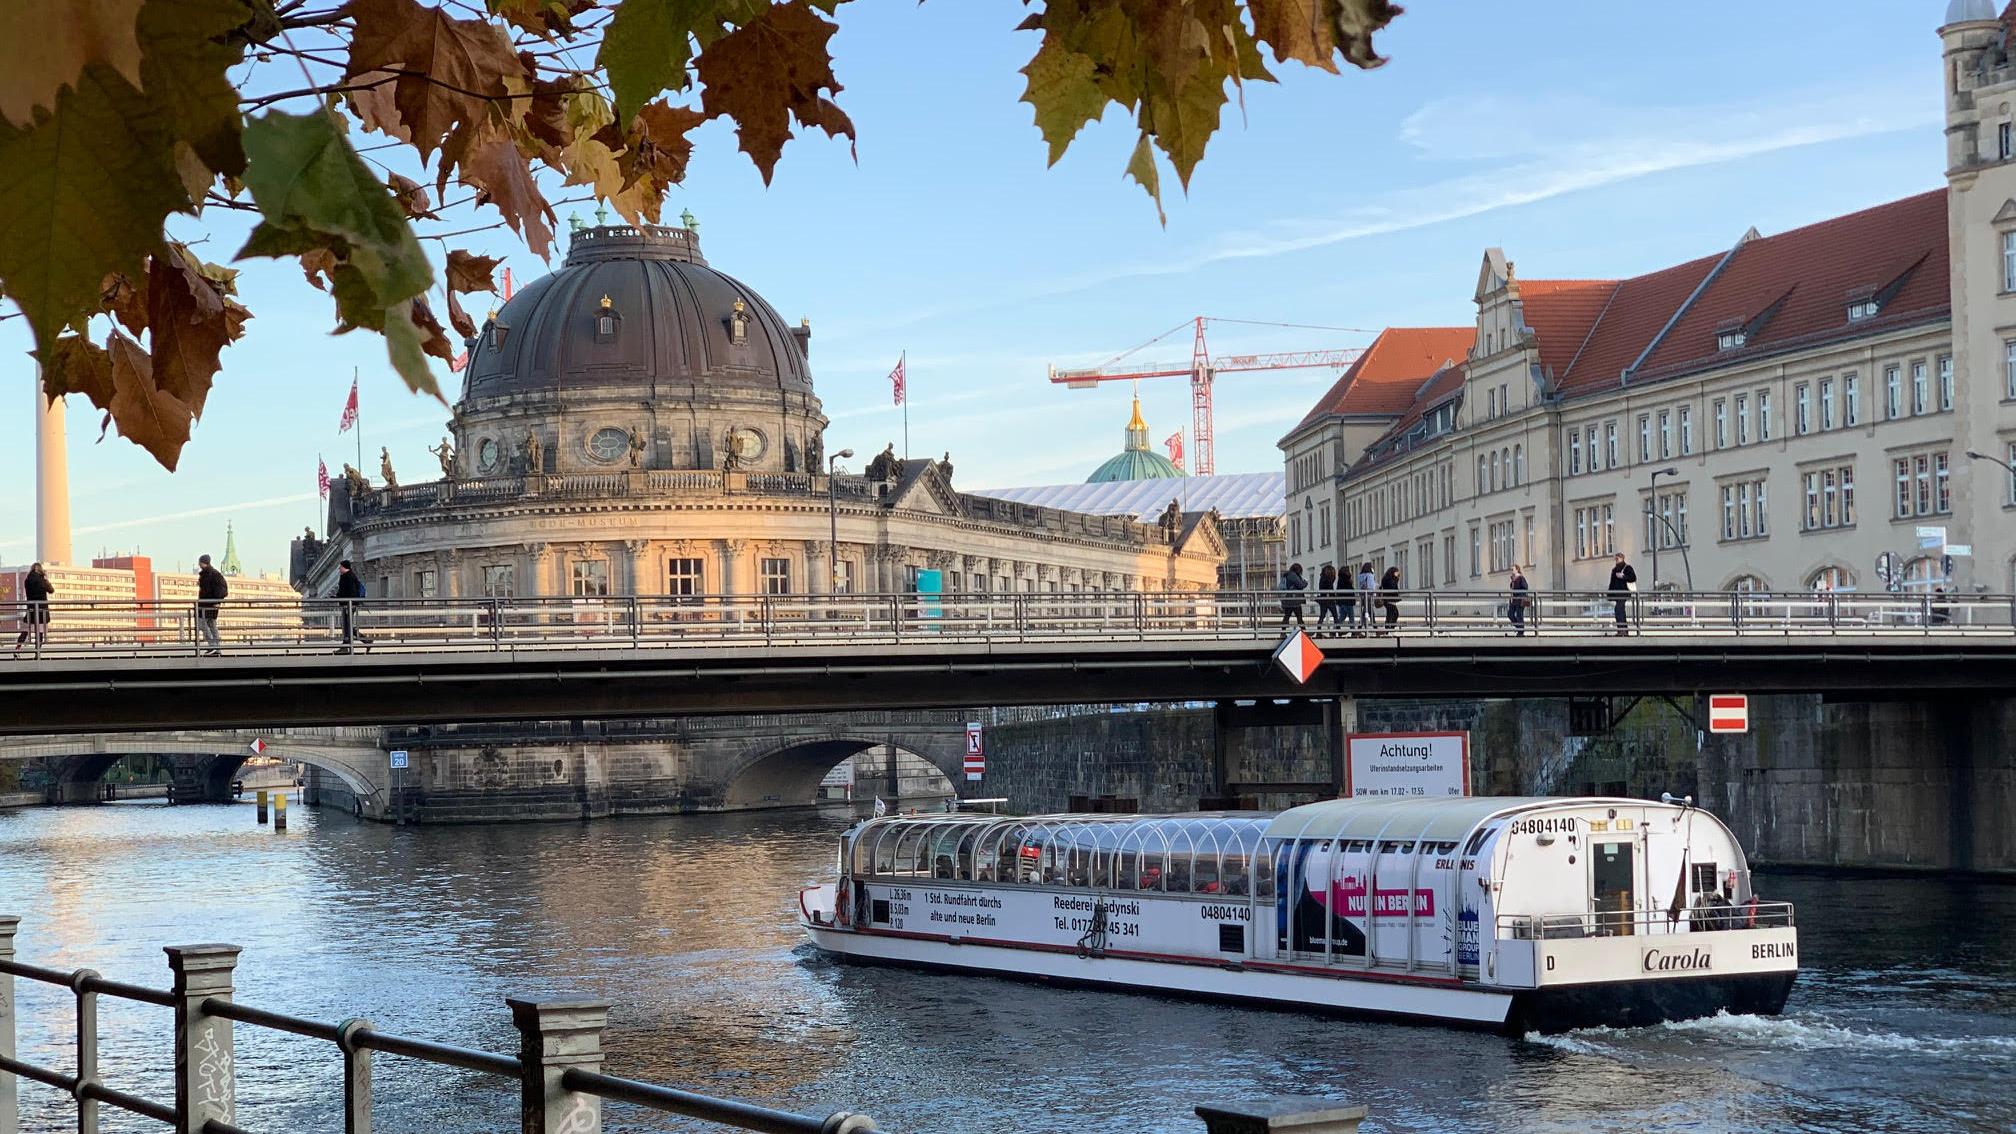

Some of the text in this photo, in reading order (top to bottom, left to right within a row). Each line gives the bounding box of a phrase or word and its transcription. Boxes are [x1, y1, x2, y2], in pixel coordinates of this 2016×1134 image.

[1380, 743, 1432, 760] Achtung!
[1381, 788, 1389, 796] km
[1512, 817, 1575, 834] 04804140
[1435, 859, 1475, 870] ERLNIS
[925, 893, 928, 904] 1
[944, 894, 977, 907] Rundfahrt
[1054, 896, 1140, 917] Reederei adynski
[1374, 895, 1386, 911] IN
[1388, 895, 1428, 911] BERIN
[930, 910, 996, 926] alte und neue Berlin
[1201, 905, 1251, 921] 04804140
[1054, 917, 1069, 930] Tel.
[1109, 921, 1120, 935] 45
[1123, 922, 1139, 937] 341
[1752, 942, 1795, 959] BERLIN
[1546, 955, 1555, 971] D
[1644, 948, 1711, 971] Carola
